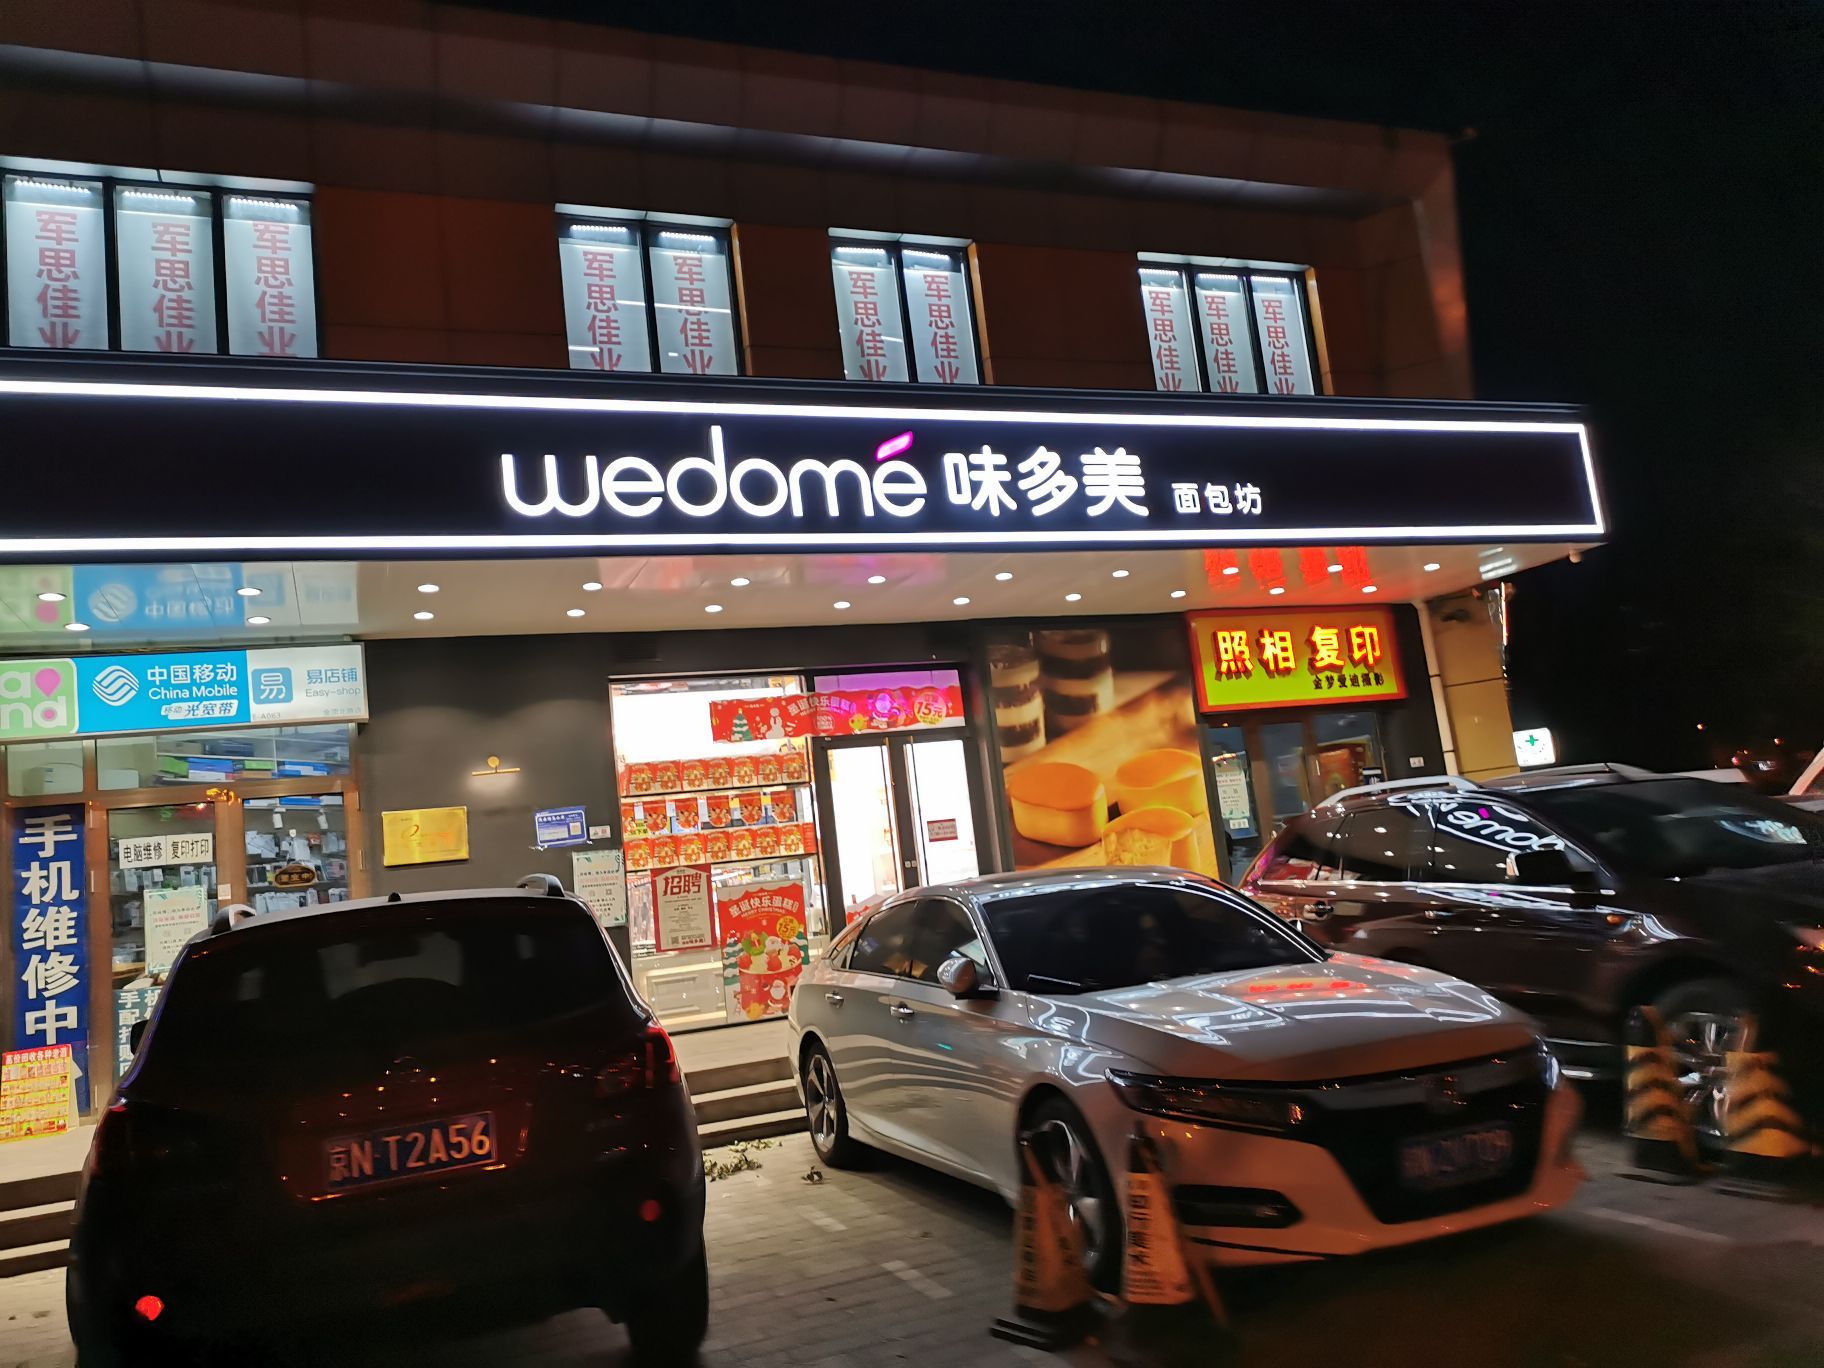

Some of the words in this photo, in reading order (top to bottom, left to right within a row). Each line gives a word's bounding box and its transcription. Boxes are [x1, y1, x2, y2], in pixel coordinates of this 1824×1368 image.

[35, 210, 81, 347] 军思佳业
[151, 222, 196, 351] 军思佳业
[252, 221, 297, 356] 军思佳业
[582, 250, 622, 372] 军思佳业
[672, 254, 714, 375] 军思佳业
[847, 270, 888, 381] 军思佳业
[922, 273, 961, 384] 军思佳业
[1148, 289, 1182, 392] 军思佳业
[1204, 295, 1240, 393] 军思佳业
[1261, 298, 1296, 395] 军思佳业
[499, 424, 928, 519] wedomé
[943, 444, 1150, 518] 味多美
[1172, 481, 1264, 516] 面包坊
[147, 662, 238, 685] 中国移动
[148, 687, 191, 700] China
[192, 684, 239, 699] Mobile
[259, 672, 287, 700] 易
[305, 667, 358, 685] 易店铺
[305, 686, 361, 699] Easy-shop
[1216, 629, 1298, 673] 照相
[1311, 625, 1382, 668] 复印
[123, 841, 163, 863] 电脑维修
[171, 838, 209, 860] 复印打印
[662, 872, 702, 897] 招聘
[19, 813, 80, 1045] 手机维修中
